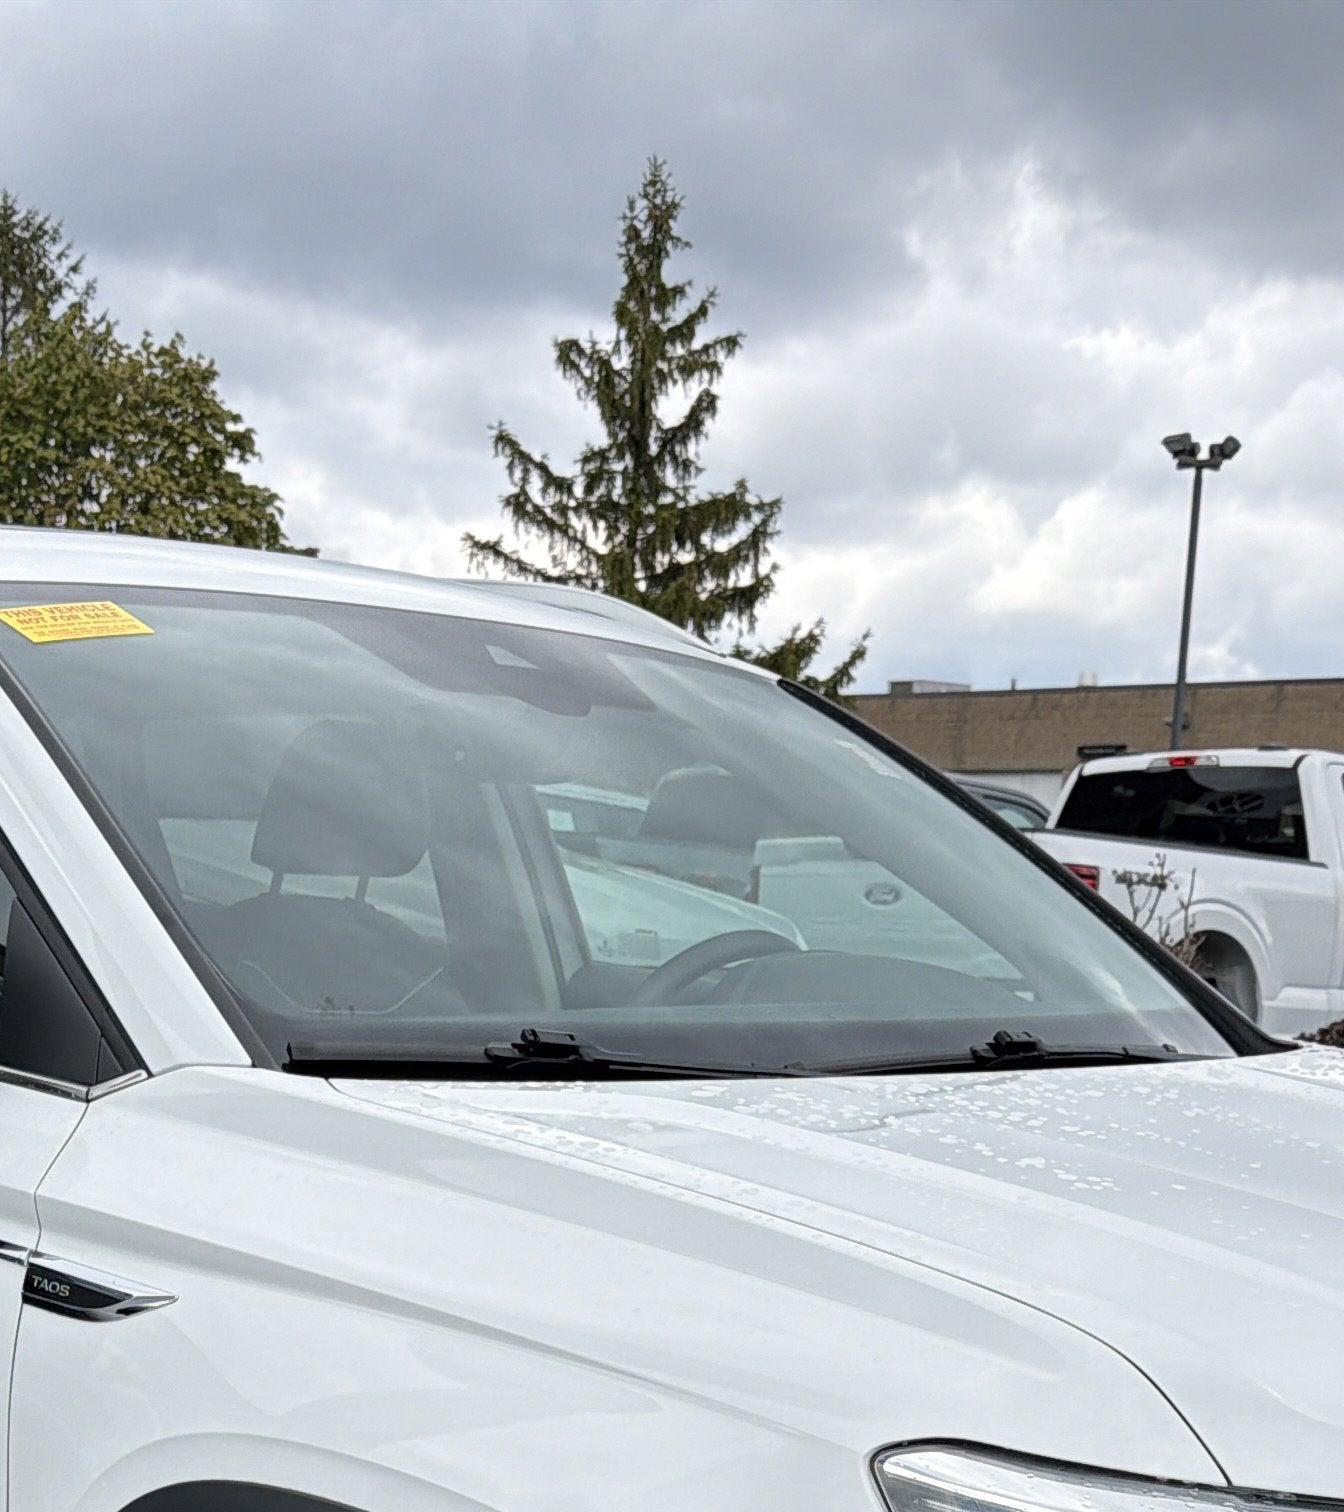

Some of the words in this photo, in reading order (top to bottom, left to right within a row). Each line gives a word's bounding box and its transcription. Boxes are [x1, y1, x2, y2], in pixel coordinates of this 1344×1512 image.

[0, 608, 43, 619] THIS
[43, 603, 116, 615] VEHICLE
[16, 616, 48, 625] NOT
[52, 613, 80, 623] FOR
[85, 611, 122, 620] SALE
[31, 1274, 71, 1297] TAOS
